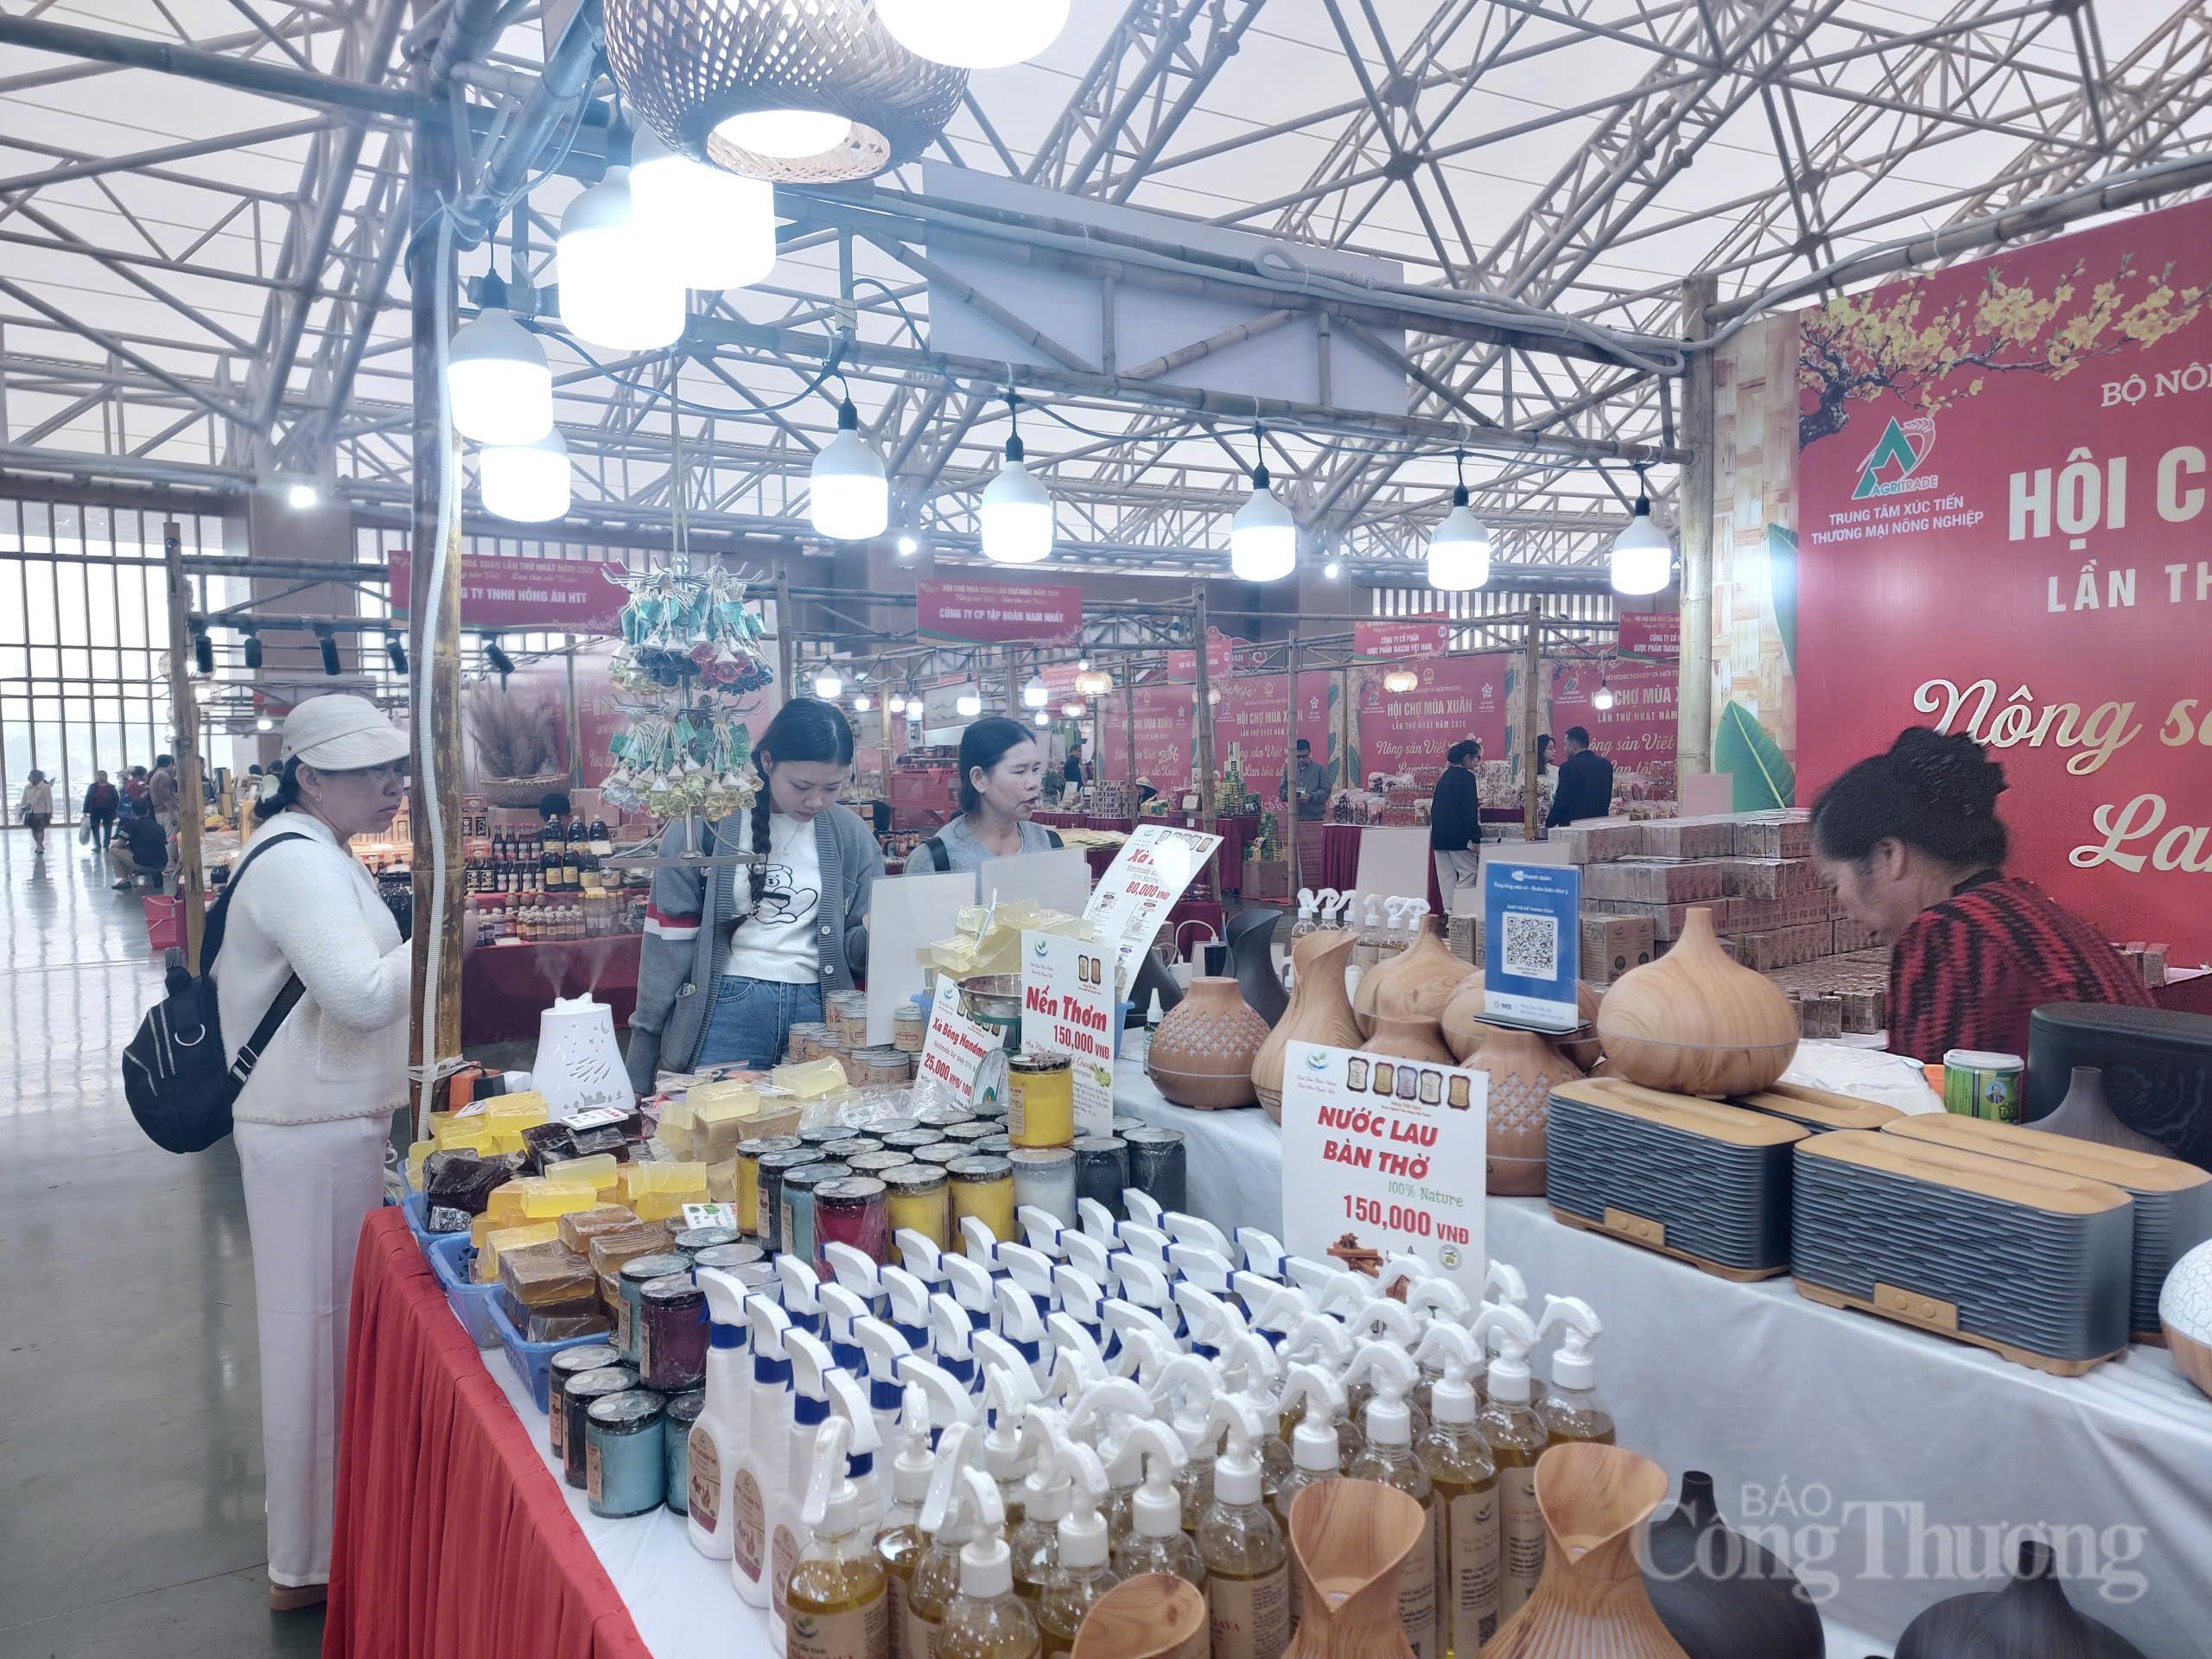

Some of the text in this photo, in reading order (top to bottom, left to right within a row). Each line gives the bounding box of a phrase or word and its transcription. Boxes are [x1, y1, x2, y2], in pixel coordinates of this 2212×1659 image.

[2101, 361, 2212, 407] BỘ NÔ
[1872, 475, 1939, 498] AGRITRADE
[2009, 447, 2127, 550] HỘI
[1829, 493, 1964, 526] TRUNG TÂM XÚC TIẾN
[1811, 509, 1985, 545] THƯƠNG MẠI NÔNG NGHIỆP
[470, 587, 483, 600] TY
[486, 588, 515, 601] TNHH
[569, 592, 588, 604] HTT
[2048, 559, 2136, 613] LẦN
[939, 607, 962, 620] CÔNG
[963, 608, 973, 620] TY
[974, 609, 985, 620] CP
[1387, 696, 1472, 719] HỘI CHỢ MÙA XUÂN
[1614, 683, 1672, 708] CHỢ MÙA
[1236, 708, 1249, 727] HỘI
[1249, 711, 1263, 727] CHỢ
[1265, 709, 1281, 724] MÙA
[1282, 709, 1303, 723] XN
[1598, 711, 1612, 723] LẦN
[1913, 679, 2143, 776] Nông
[1376, 739, 1446, 759] Nông sản Việt
[1588, 734, 1675, 757] ông sản Việt
[1275, 763, 1286, 777] sắ
[1126, 881, 1160, 898] 80,000
[1026, 983, 1108, 1032] Nến Thơm
[942, 1022, 960, 1046] Bông
[1053, 1024, 1093, 1055] 150,000
[924, 1052, 950, 1081] 25,000
[1317, 1105, 1386, 1138] NƯỚC
[1389, 1120, 1439, 1147] LAU
[1323, 1138, 1431, 1180] BÀN THỜ
[1388, 1180, 1464, 1207] 100% Nature
[1343, 1194, 1470, 1245] 150,000 VNĐ
